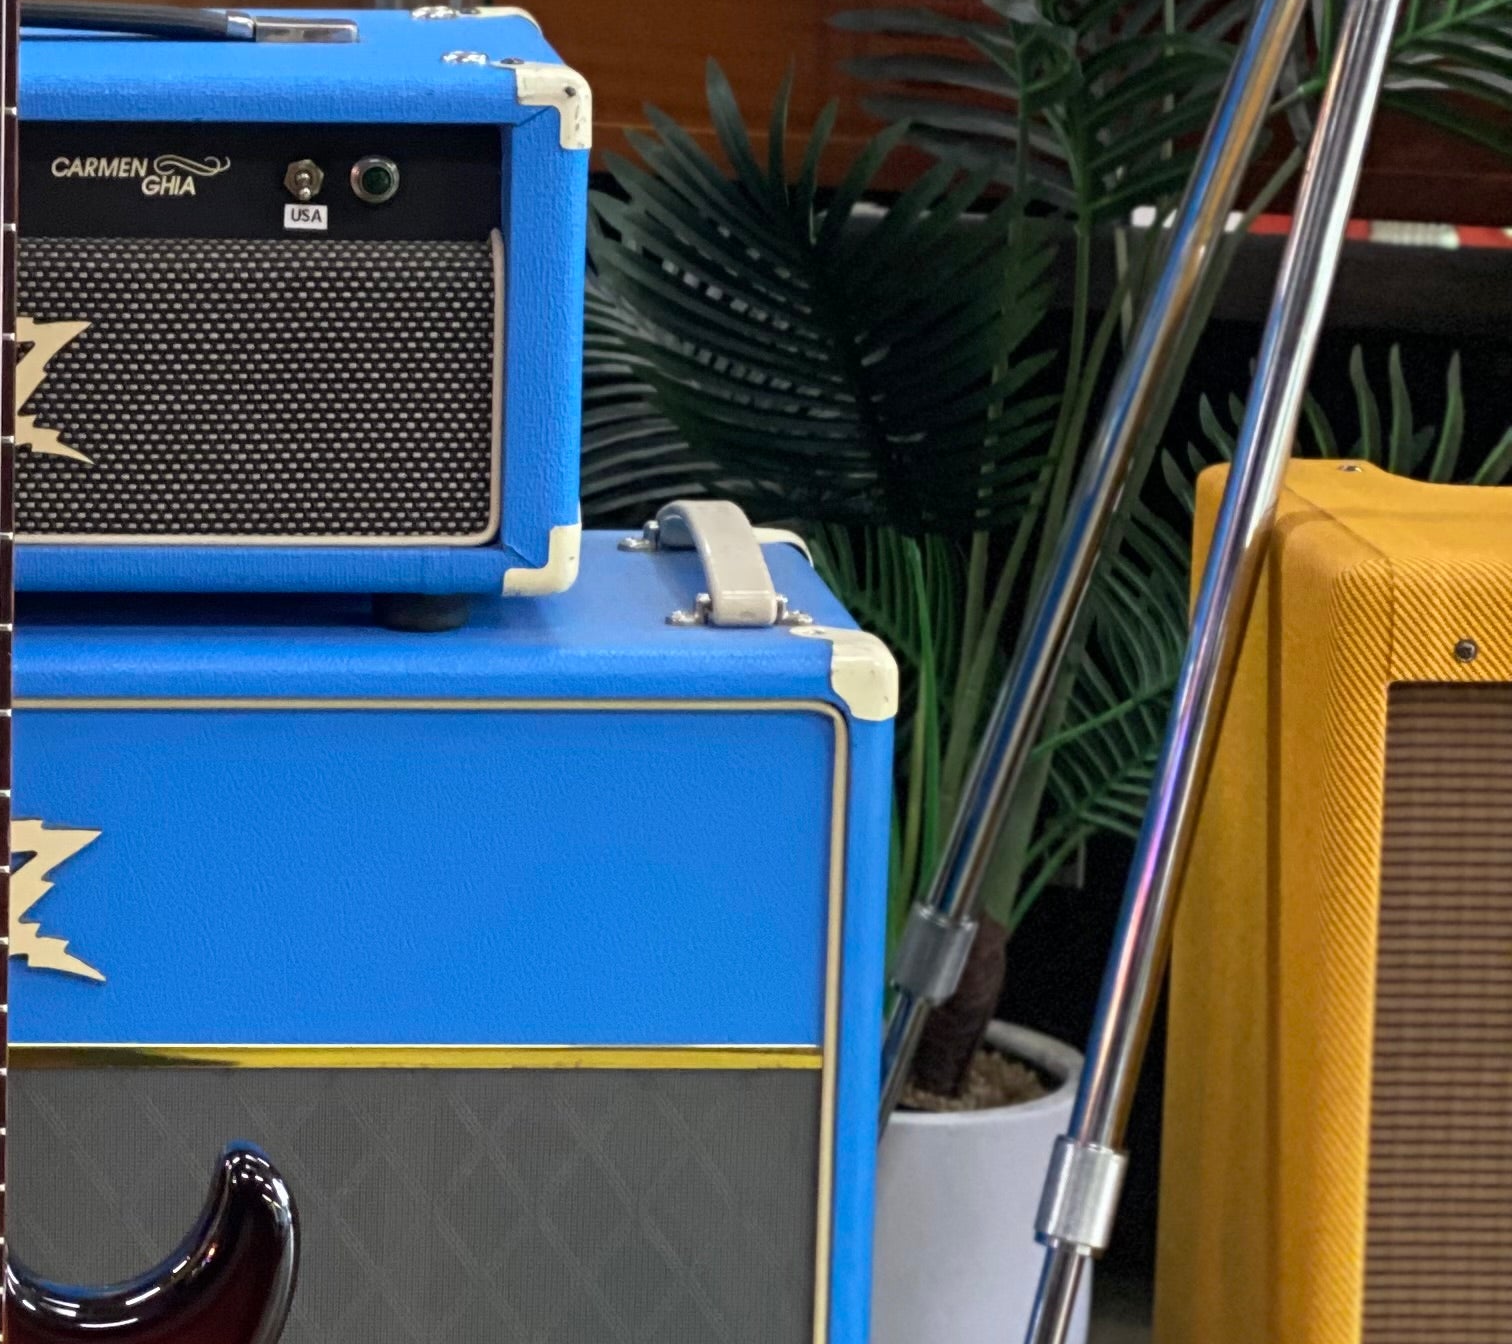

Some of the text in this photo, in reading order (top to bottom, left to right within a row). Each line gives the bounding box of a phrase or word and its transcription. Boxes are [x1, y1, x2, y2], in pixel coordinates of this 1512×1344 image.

[50, 157, 149, 177] CARMEN
[141, 175, 196, 196] GHIA
[290, 208, 322, 224] USA
